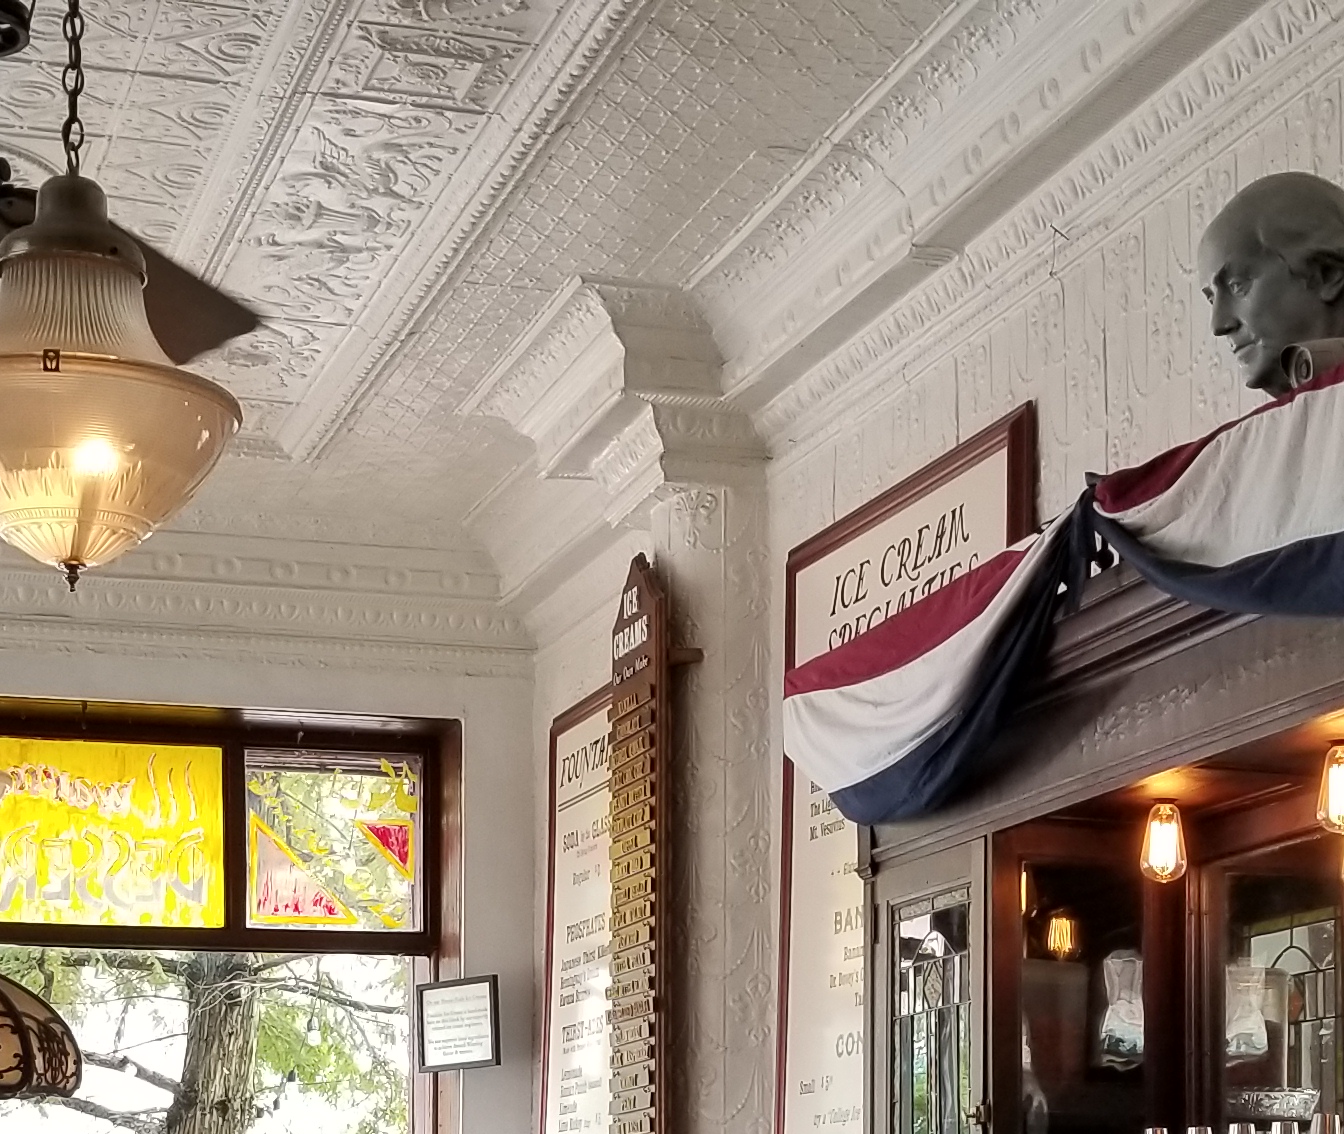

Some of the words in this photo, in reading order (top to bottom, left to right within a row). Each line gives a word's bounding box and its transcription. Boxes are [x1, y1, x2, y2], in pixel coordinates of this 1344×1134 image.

[830, 559, 871, 617] ICE
[881, 503, 969, 587] CREAM
[623, 586, 638, 619] ICE
[614, 615, 649, 660] CREAMS
[559, 733, 610, 789] FOUNTAI
